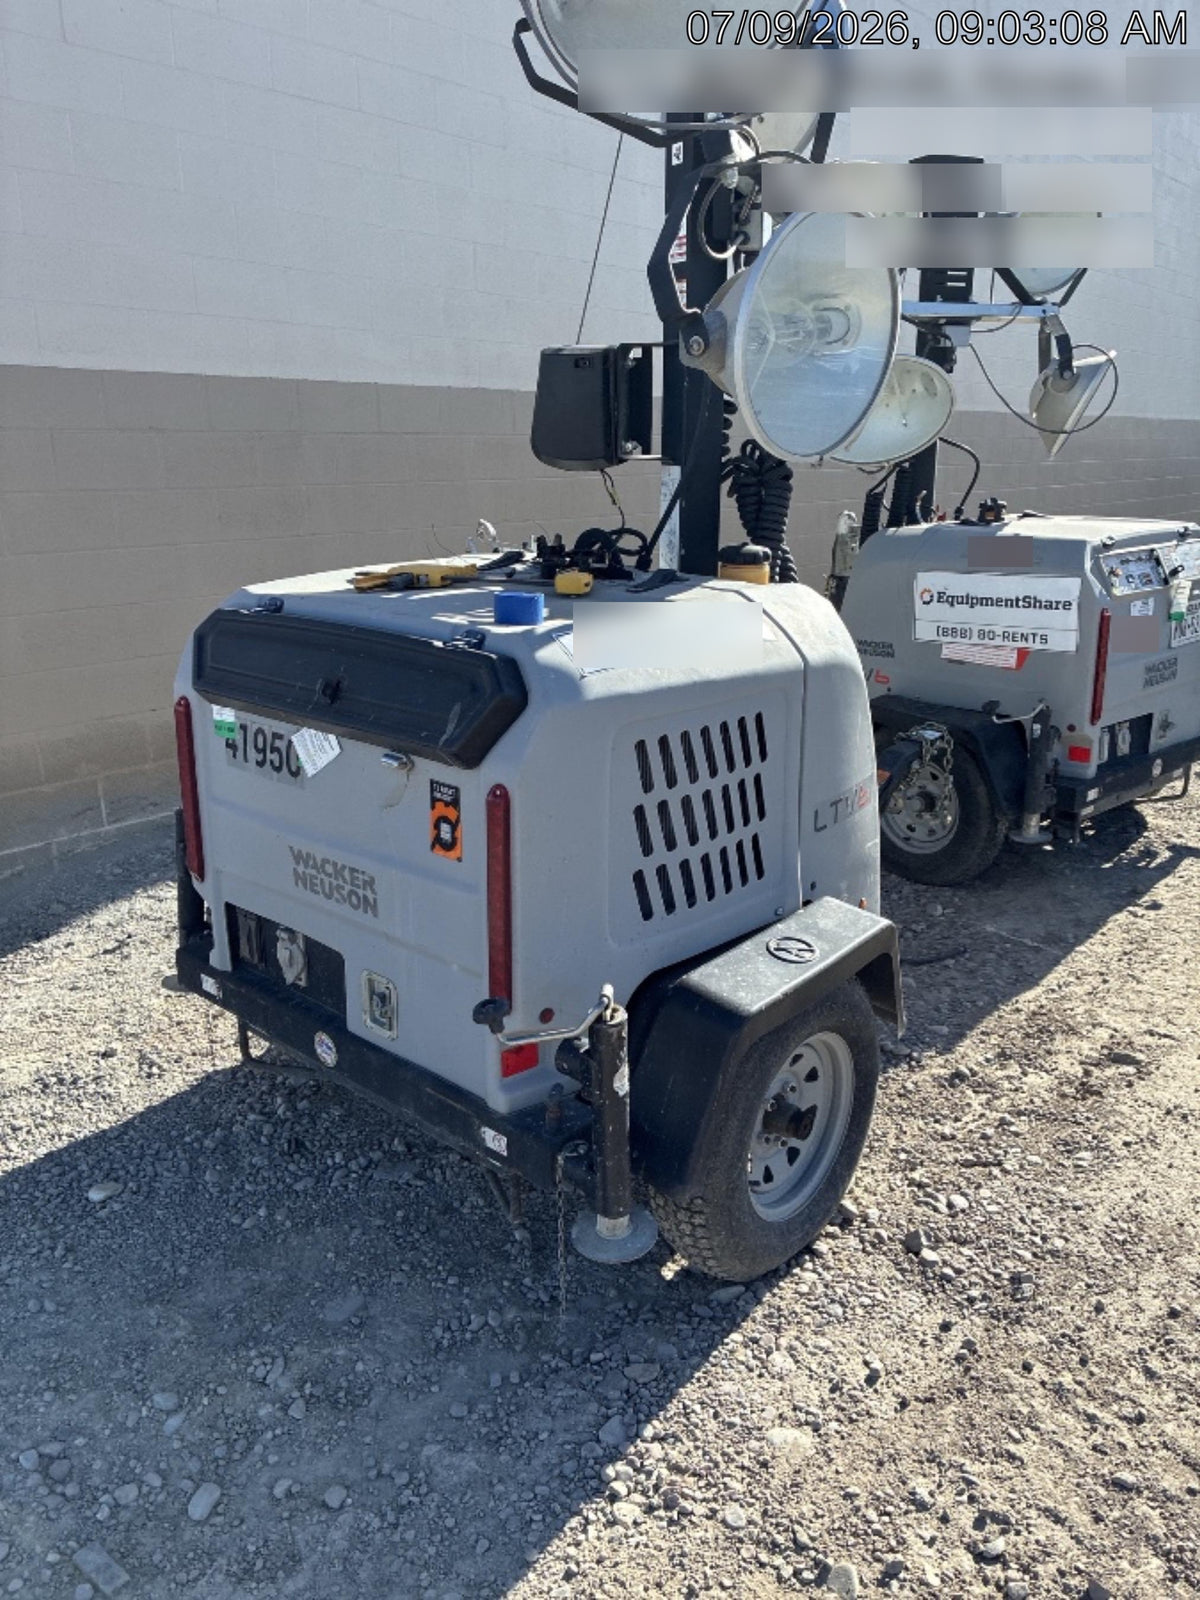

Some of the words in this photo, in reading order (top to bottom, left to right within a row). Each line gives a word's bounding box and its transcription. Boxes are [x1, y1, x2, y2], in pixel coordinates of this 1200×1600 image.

[936, 591, 1073, 611] EquipmentShare
[936, 625, 973, 640] (888)
[977, 629, 1049, 645] 80-RENTS
[288, 845, 378, 897] WACKER
[292, 867, 379, 919] NEUSON
